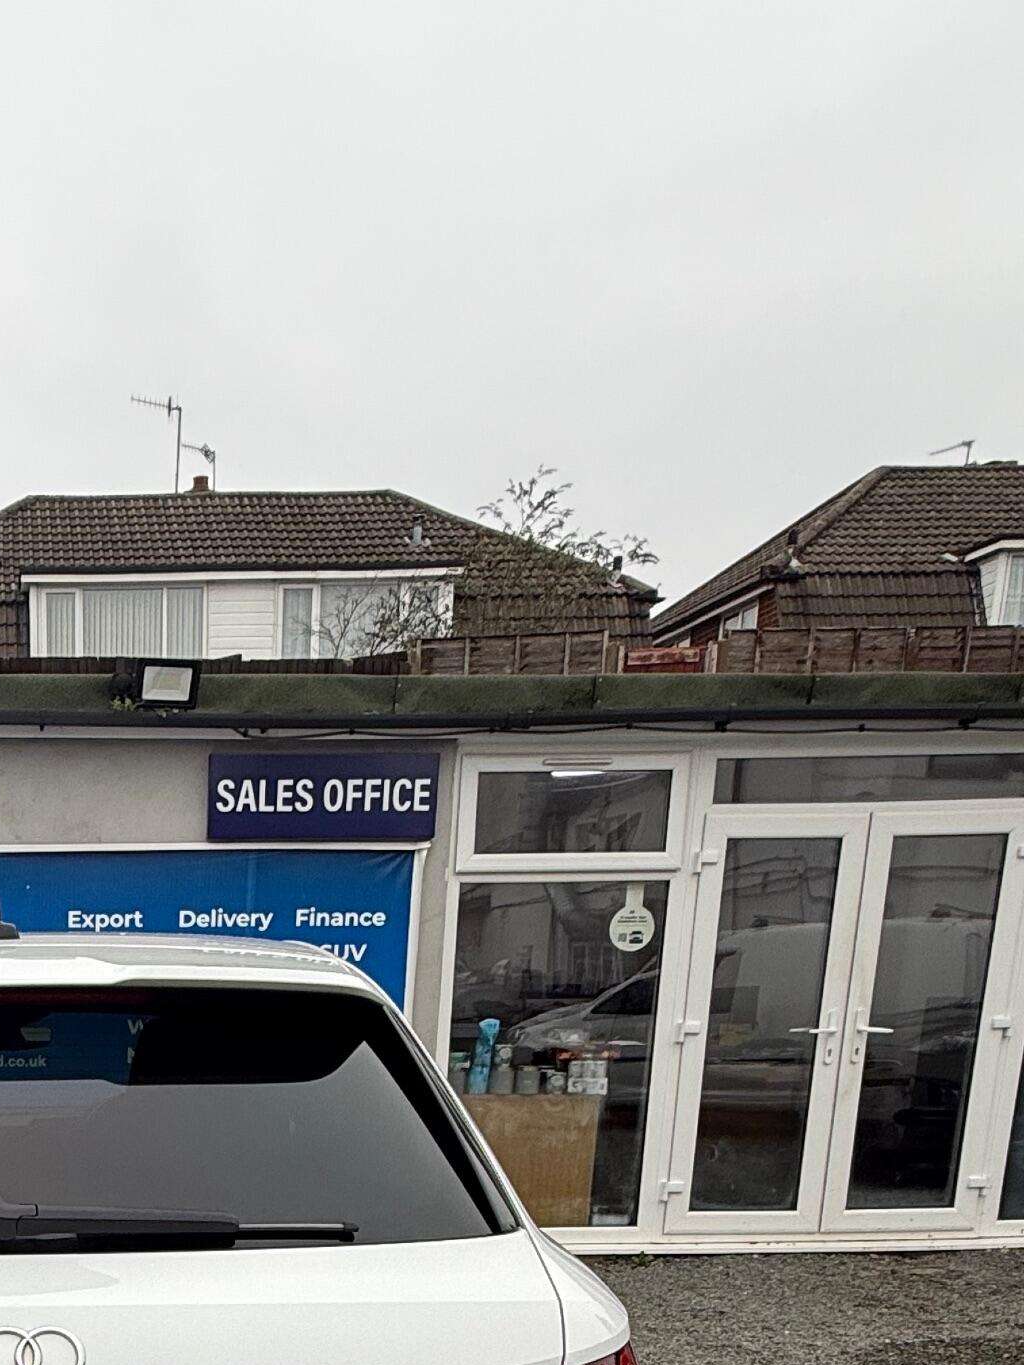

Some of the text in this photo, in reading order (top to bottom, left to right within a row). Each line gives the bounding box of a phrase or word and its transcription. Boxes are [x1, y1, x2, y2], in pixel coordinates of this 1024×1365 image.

[215, 778, 432, 813] SALES OFFICE
[67, 907, 387, 932] Export Delivery Finance
